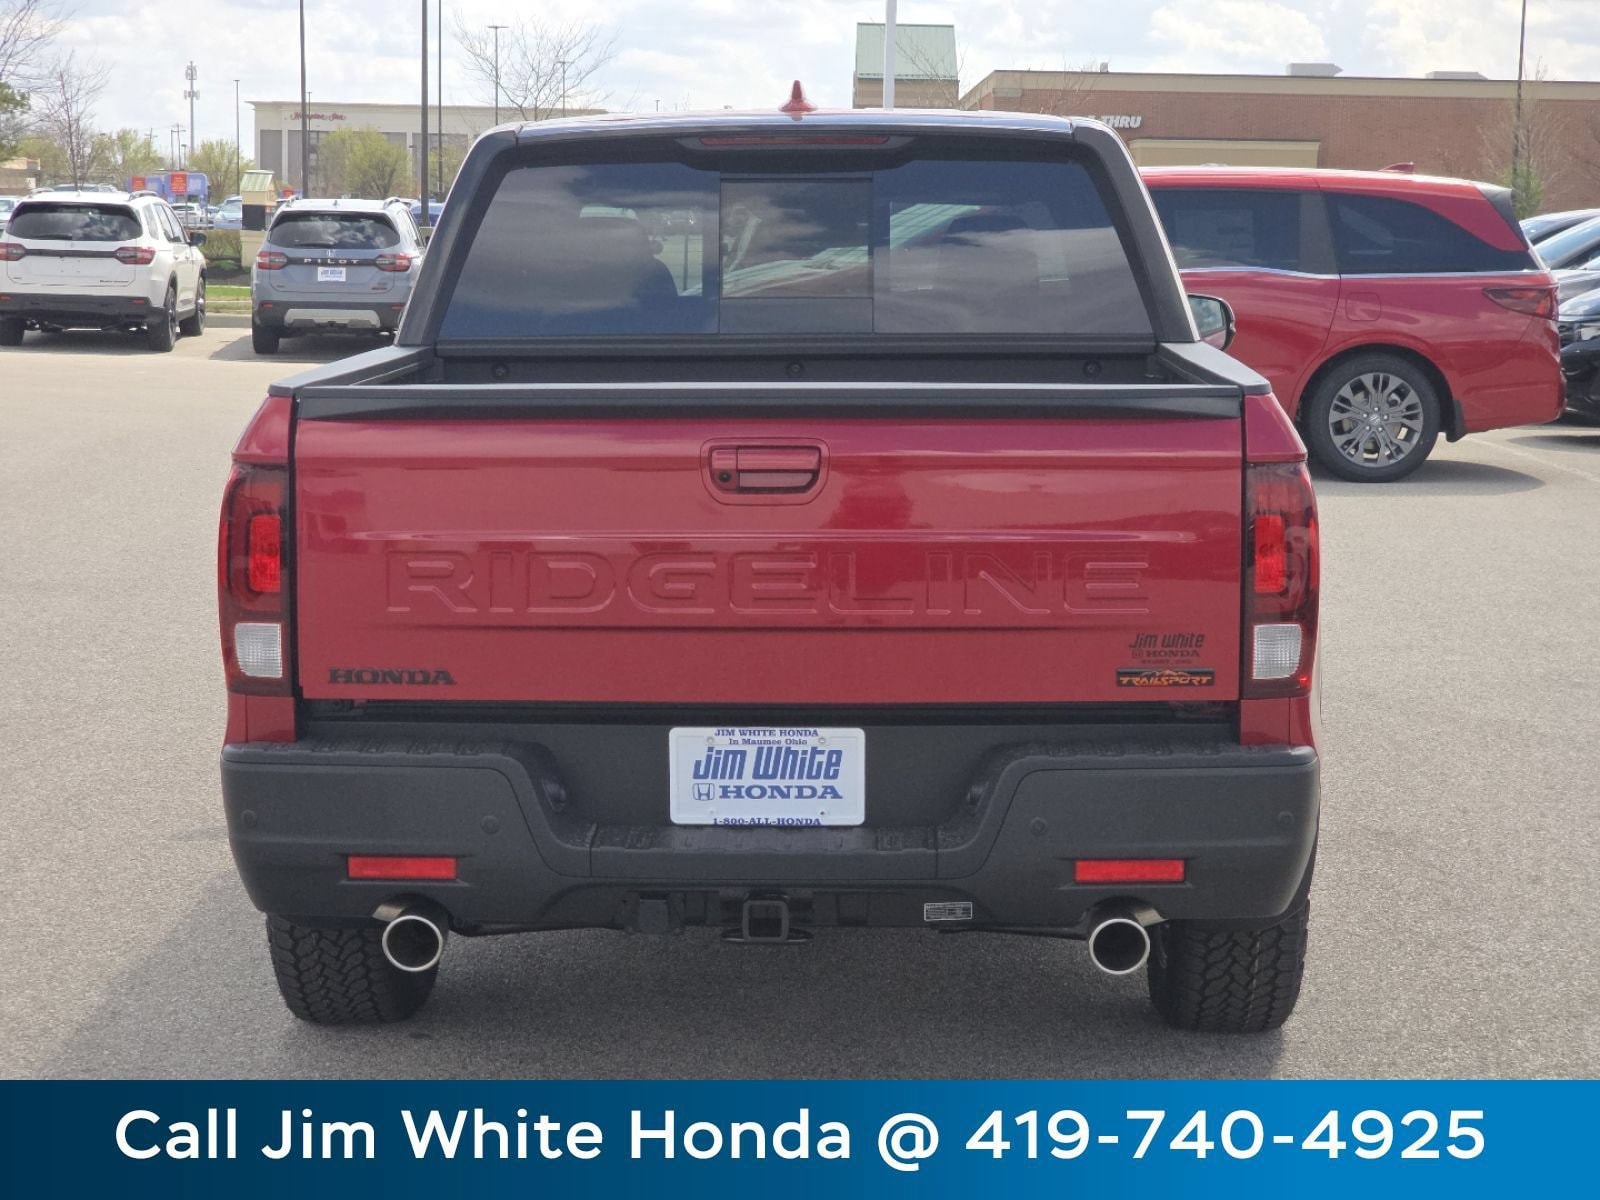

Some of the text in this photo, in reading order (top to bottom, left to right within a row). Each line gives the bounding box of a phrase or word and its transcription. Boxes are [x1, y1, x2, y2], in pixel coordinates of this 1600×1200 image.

[1101, 115, 1142, 128] THRU
[385, 550, 1150, 614] RIDGELINE
[1128, 633, 1158, 649] Jim
[328, 668, 457, 685] HONDA
[1119, 676, 1212, 686] TRAILSPORT
[714, 729, 819, 737] JIM WHITE HONDA
[692, 746, 843, 780] Jim White
[718, 785, 843, 800] HONDA
[713, 817, 821, 826] 1-800-ALL-HONDA
